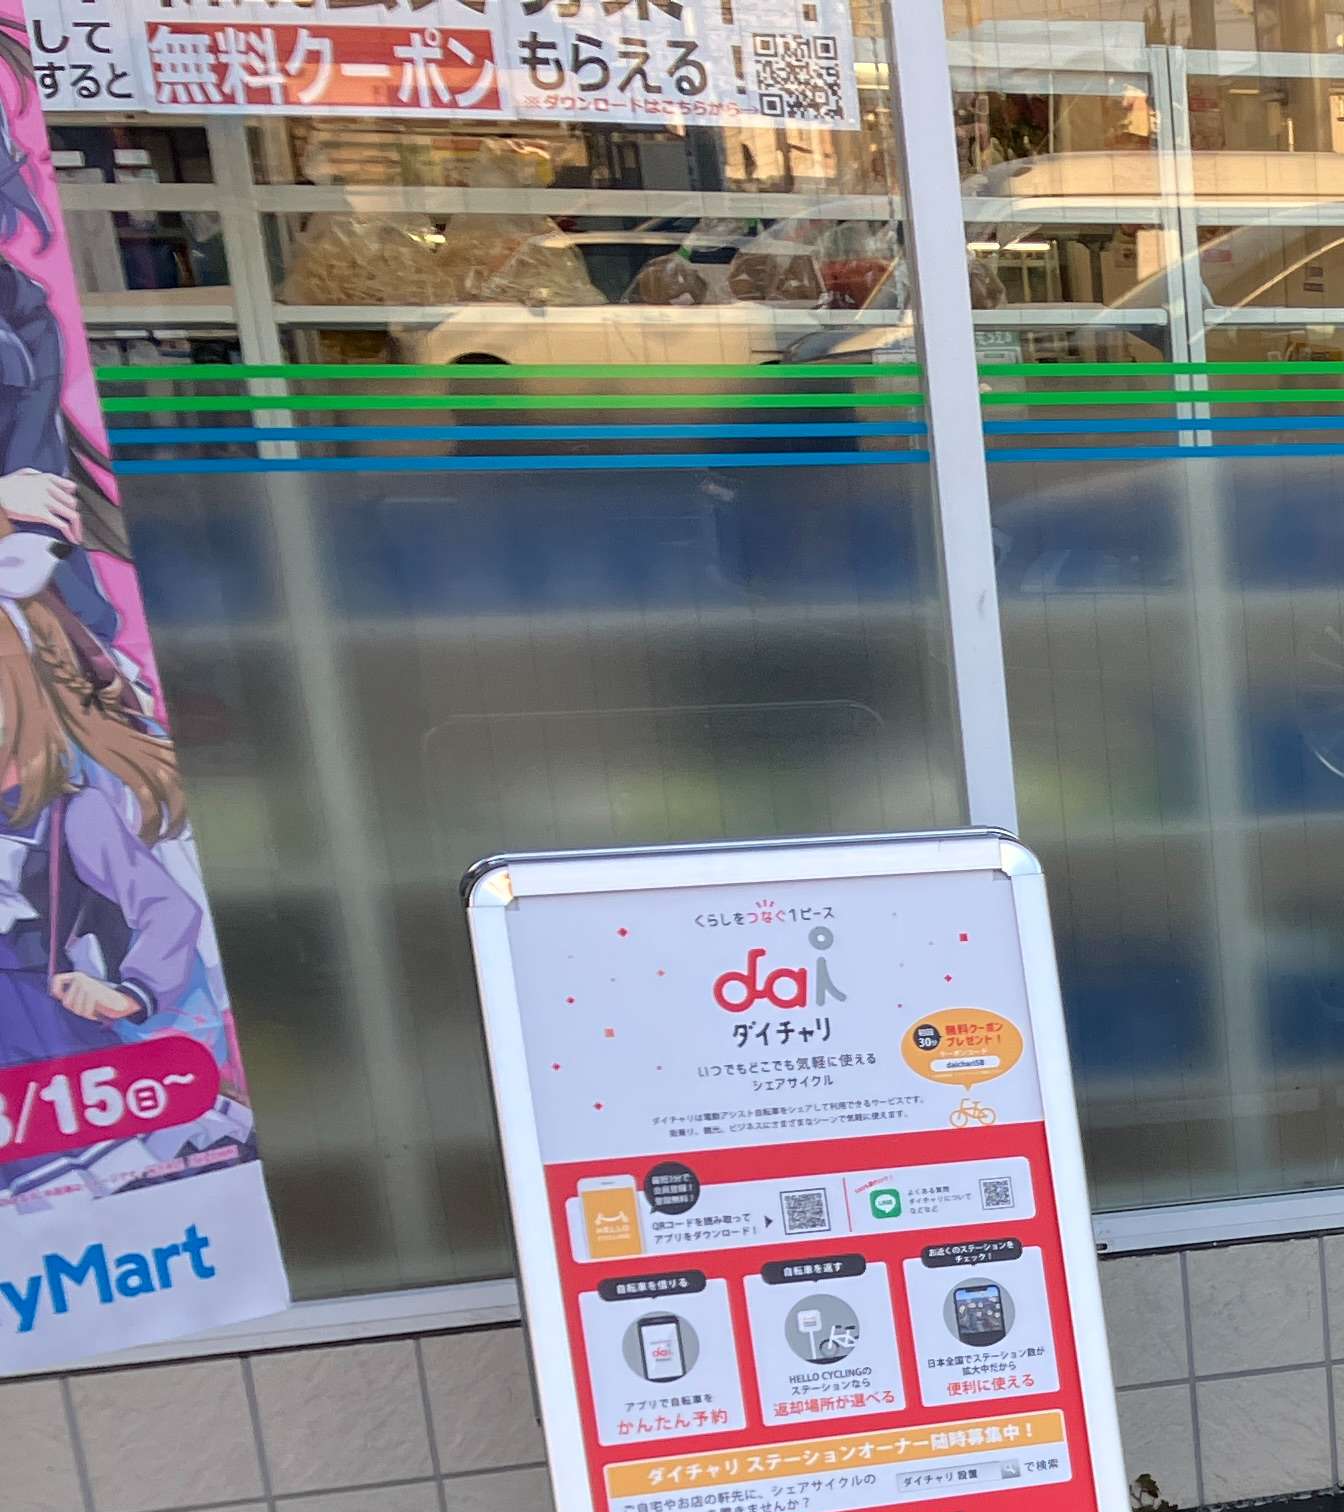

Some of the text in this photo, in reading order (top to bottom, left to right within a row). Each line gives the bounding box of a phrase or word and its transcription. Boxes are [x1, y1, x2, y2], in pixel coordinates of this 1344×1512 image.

[32, 19, 111, 54] して
[150, 24, 496, 108] 無料クーポン
[33, 61, 133, 99] すると
[733, 1017, 831, 1048] ダイチャリ
[945, 1022, 1003, 1036] 無料クーポン
[698, 1052, 877, 1078] いつでもどこでも気軽に使える
[752, 1074, 834, 1092] シェアサイクル
[783, 1261, 843, 1277] 自転車を返す
[616, 1278, 689, 1295] 自転車を借りる
[927, 1346, 1045, 1369] 日本全国でステーション数が
[962, 1361, 1017, 1376] 拡大中だから
[788, 1373, 820, 1384] HELLO
[791, 1379, 872, 1397] ステーションなら
[947, 1374, 1035, 1397] 便利に使える
[625, 1393, 713, 1413] アプリで自転車を
[773, 1390, 895, 1418] 返却場所が選べる
[617, 1408, 728, 1436] かんたん予約
[647, 1459, 739, 1486] ダイチャリ
[1024, 1458, 1059, 1472] で検索
